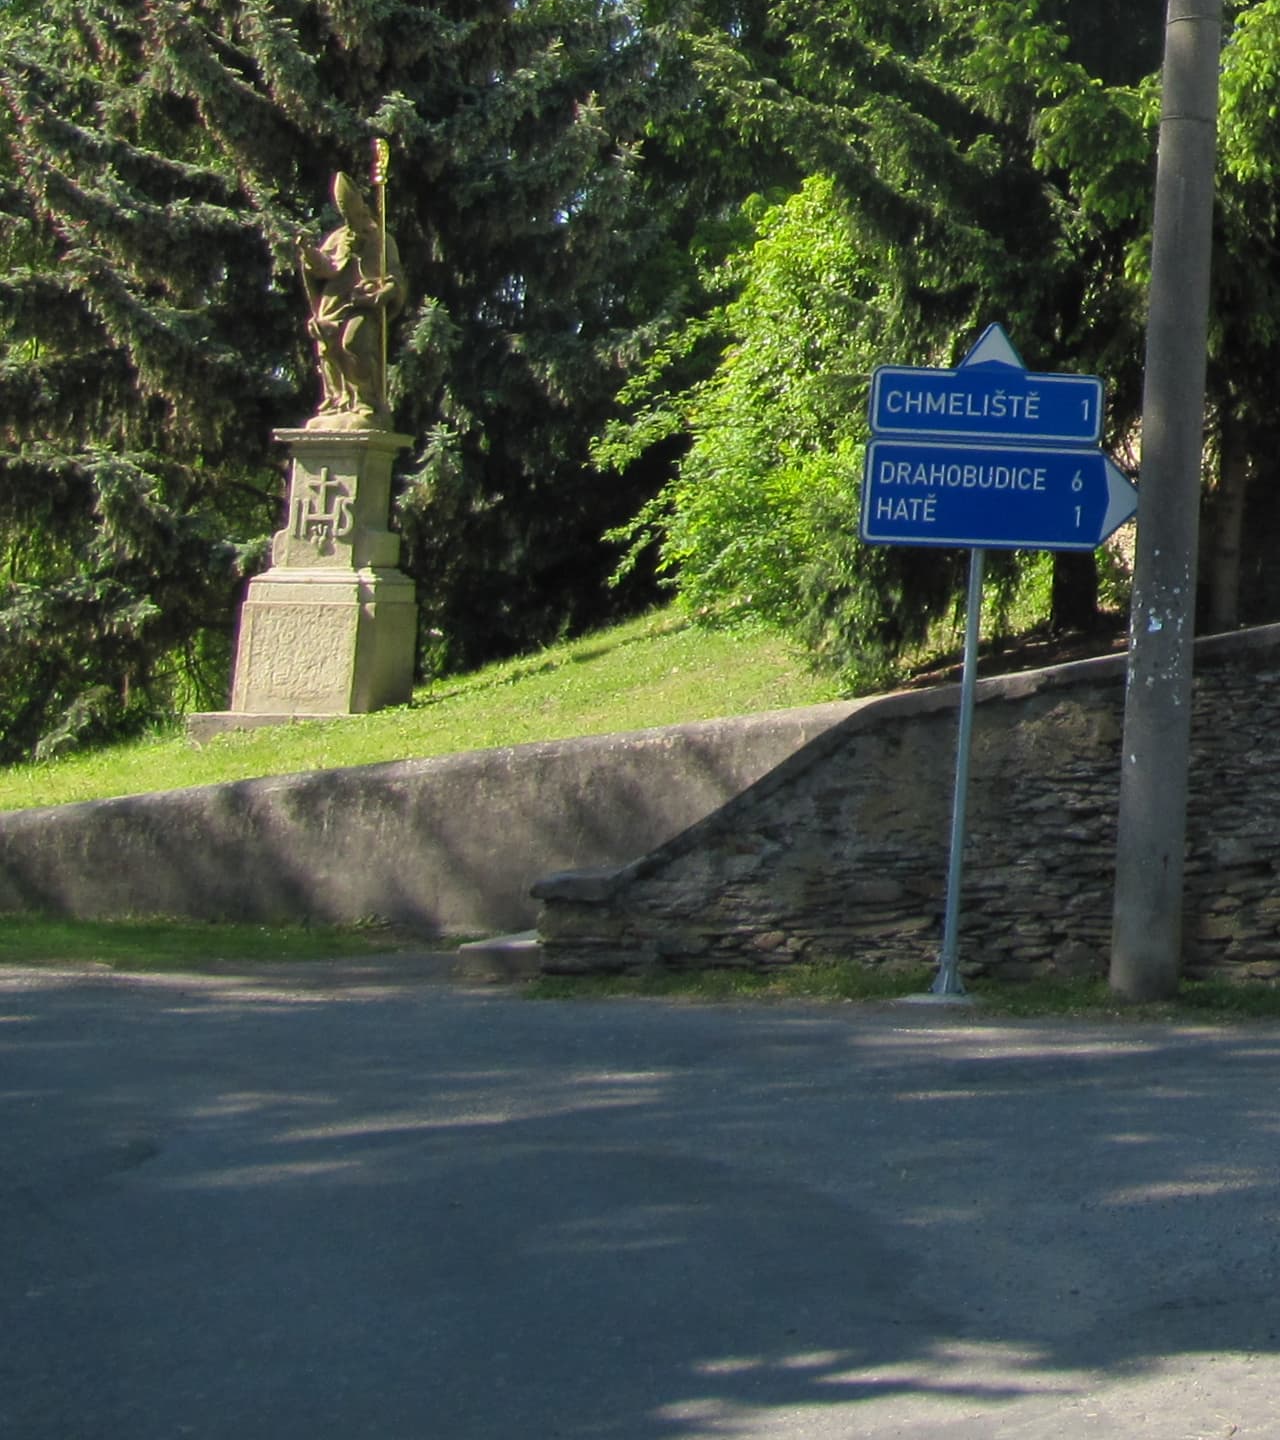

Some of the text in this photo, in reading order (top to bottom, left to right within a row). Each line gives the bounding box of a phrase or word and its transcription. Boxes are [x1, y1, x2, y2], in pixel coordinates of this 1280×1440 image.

[886, 390, 1090, 421] CHMELIŠTĚ 1
[879, 461, 1083, 492] DRAHOBUDICE 6
[876, 493, 1082, 528] HATĚ 1
